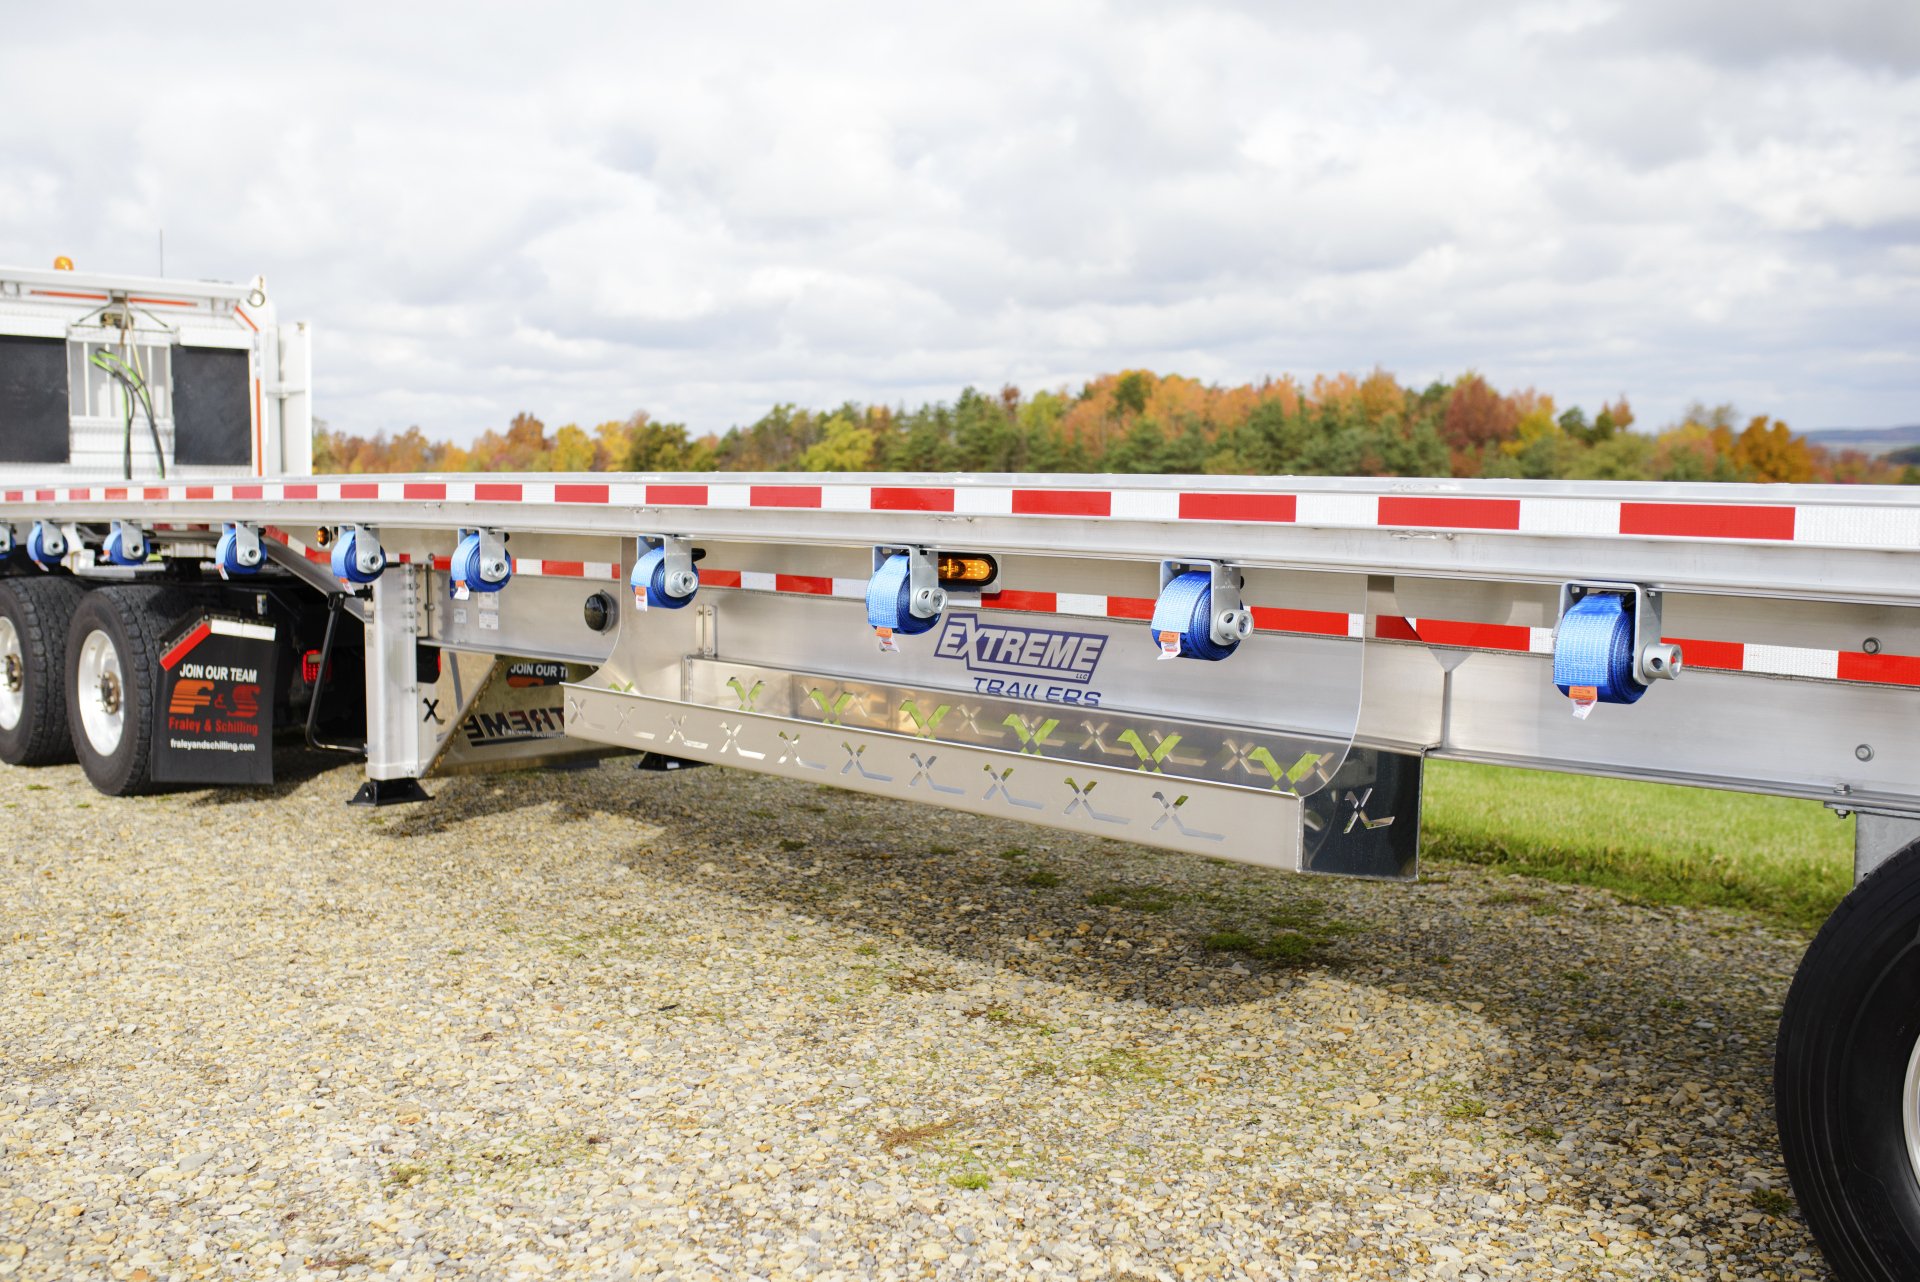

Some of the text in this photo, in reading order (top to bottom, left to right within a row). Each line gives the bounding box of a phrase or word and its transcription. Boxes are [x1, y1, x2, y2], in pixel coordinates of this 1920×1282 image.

[936, 616, 1104, 678] EXTREME
[179, 663, 257, 683] JOIN OUR TEAM
[510, 663, 534, 676] JOIN
[535, 664, 558, 677] OUR
[1076, 673, 1089, 681] LLC
[168, 717, 259, 737] Fraley & Schilling
[170, 738, 255, 752] fraleyandschilling.com
